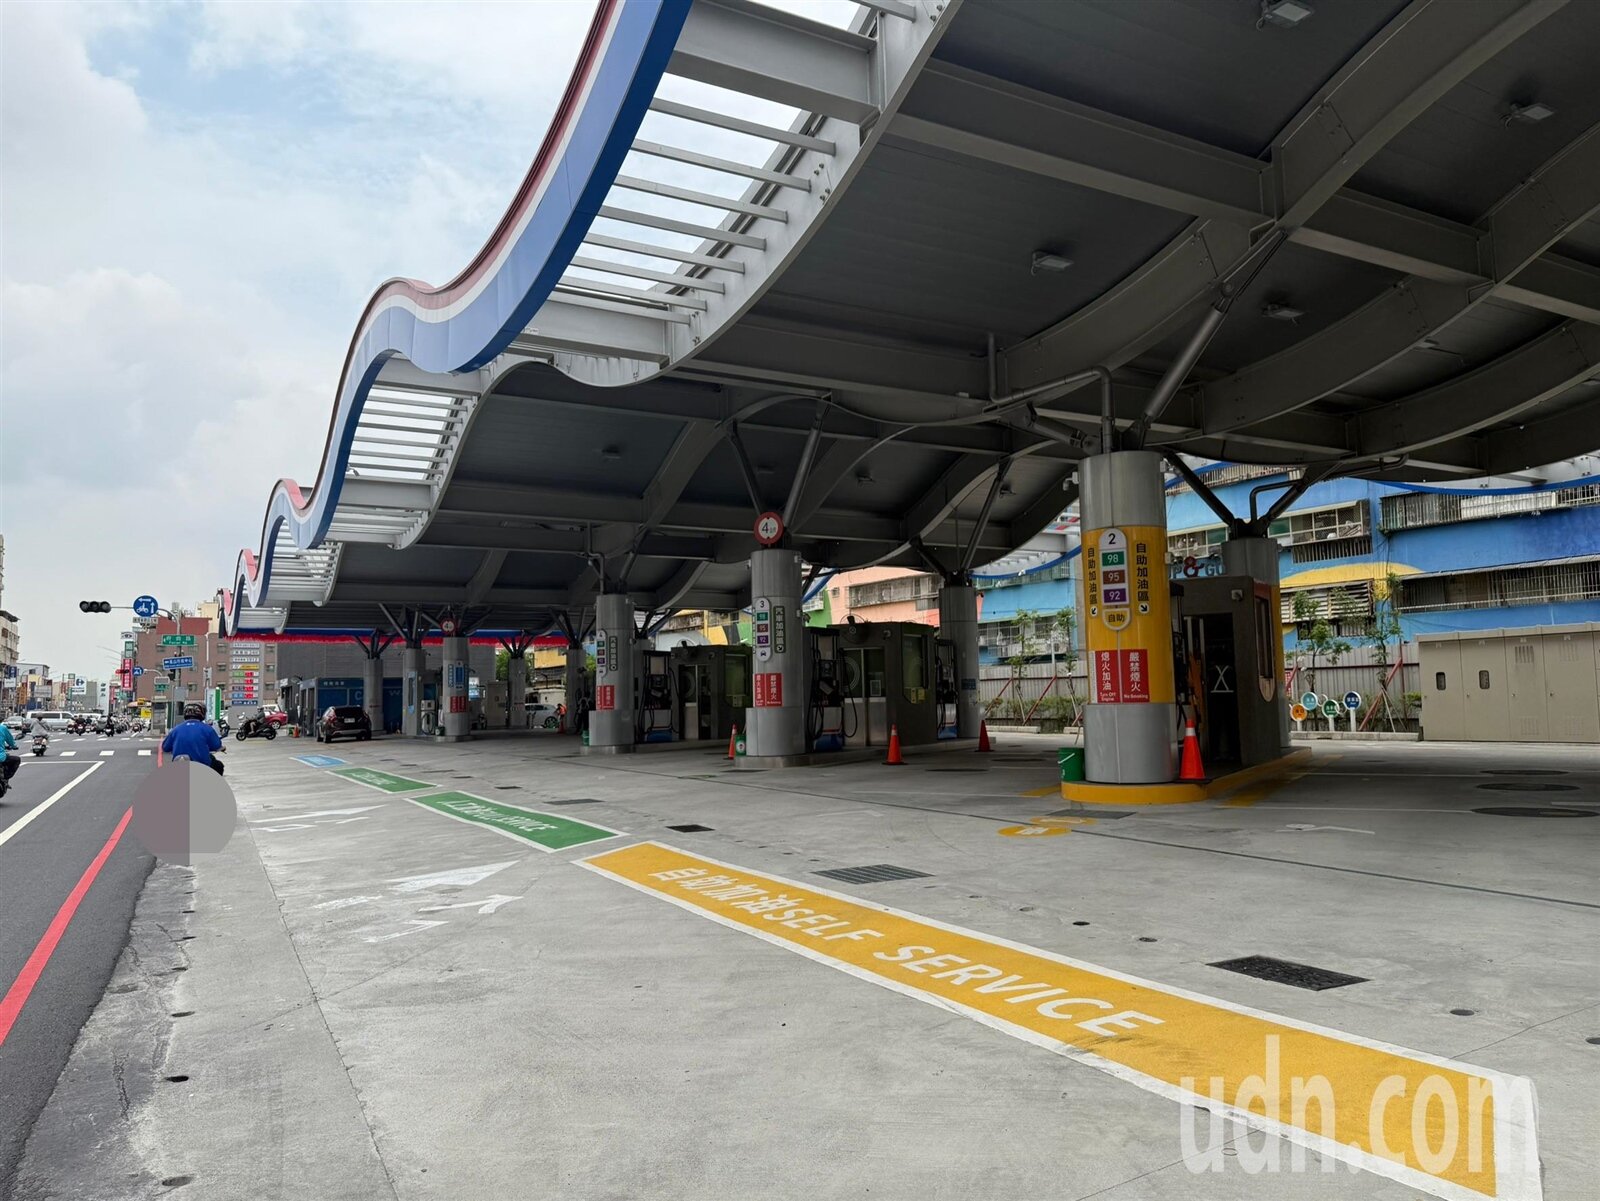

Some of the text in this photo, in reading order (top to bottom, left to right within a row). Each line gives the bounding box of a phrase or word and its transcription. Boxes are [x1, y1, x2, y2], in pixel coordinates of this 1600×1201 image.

[1108, 533, 1116, 545] 2
[1107, 554, 1119, 564] 98
[1088, 548, 1098, 605] 自助加油區
[1108, 572, 1120, 581] 95
[1136, 543, 1149, 602] 自助加油區
[1109, 591, 1121, 600] 92
[760, 600, 765, 608] 3
[1108, 613, 1125, 623] 自助
[1101, 652, 1112, 691] 熄火加油
[1129, 652, 1141, 692] 嚴禁煙火
[873, 945, 1166, 1037] SERVICE
